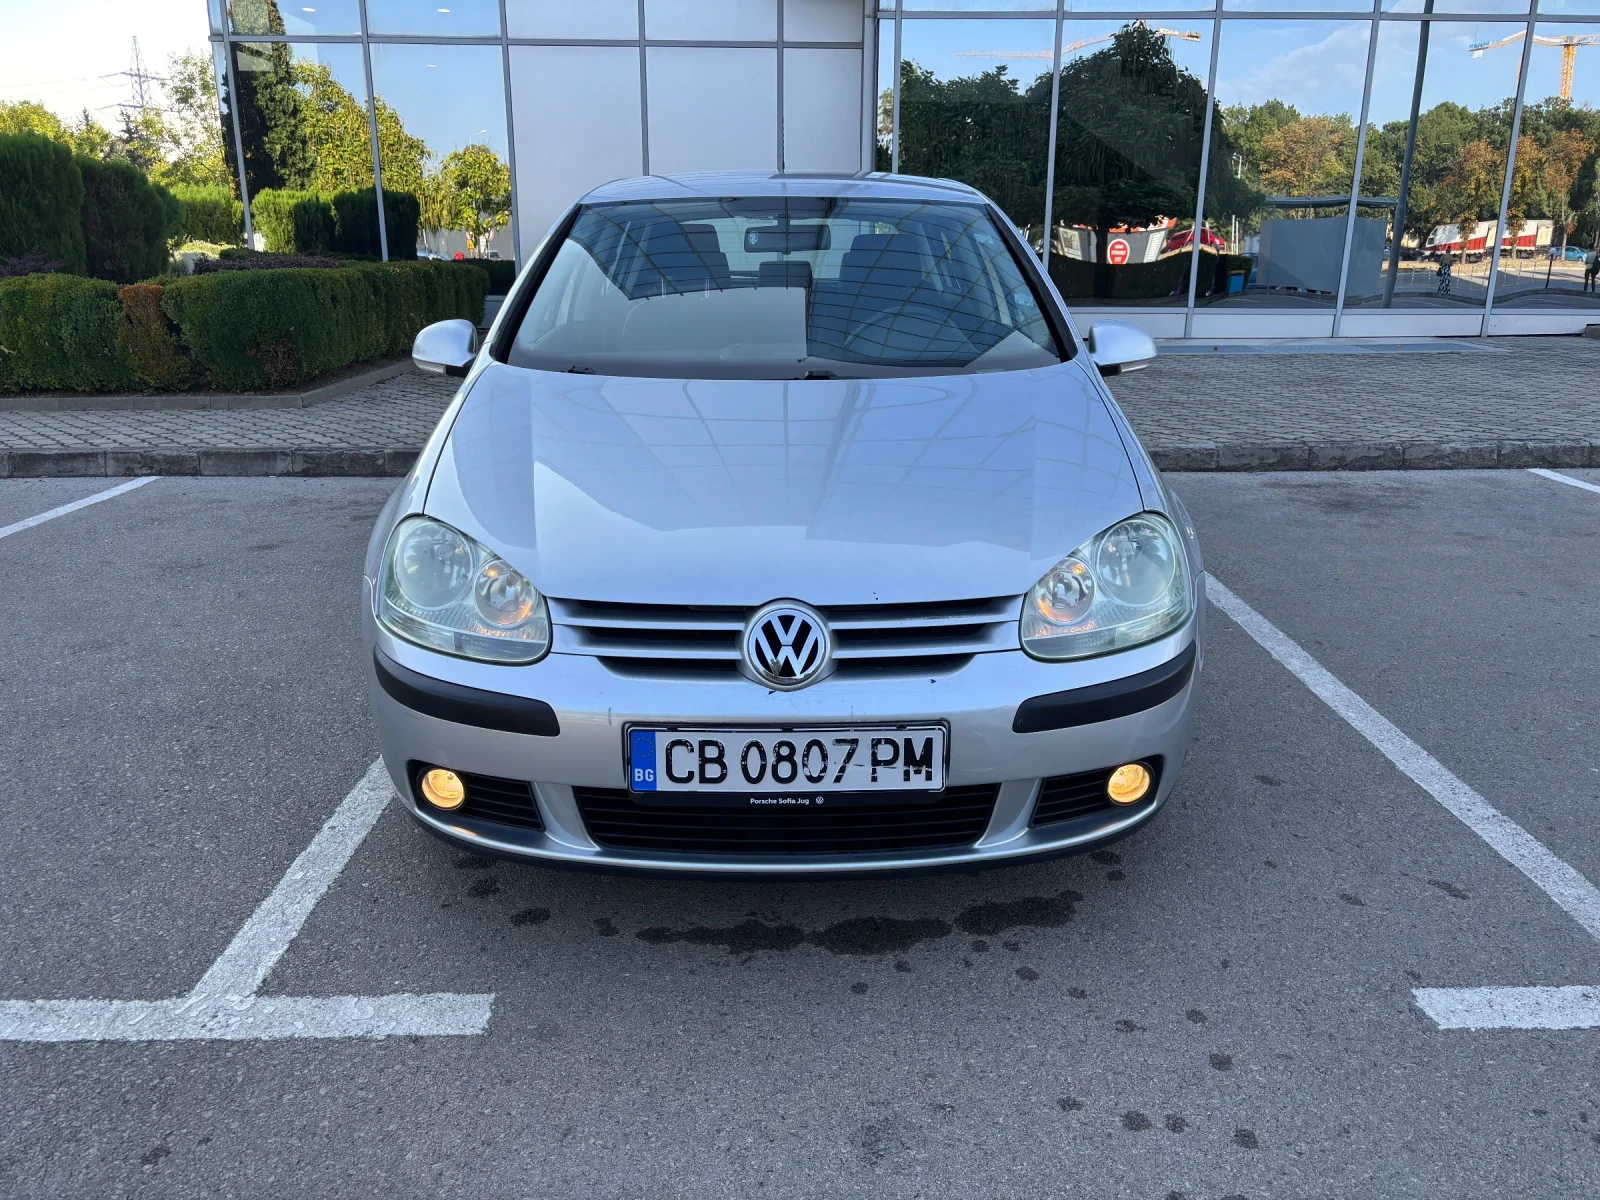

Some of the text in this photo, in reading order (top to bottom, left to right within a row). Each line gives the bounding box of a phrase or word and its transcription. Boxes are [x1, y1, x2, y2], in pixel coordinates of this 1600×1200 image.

[635, 768, 654, 782] BG
[665, 737, 933, 784] CB 0807 PM
